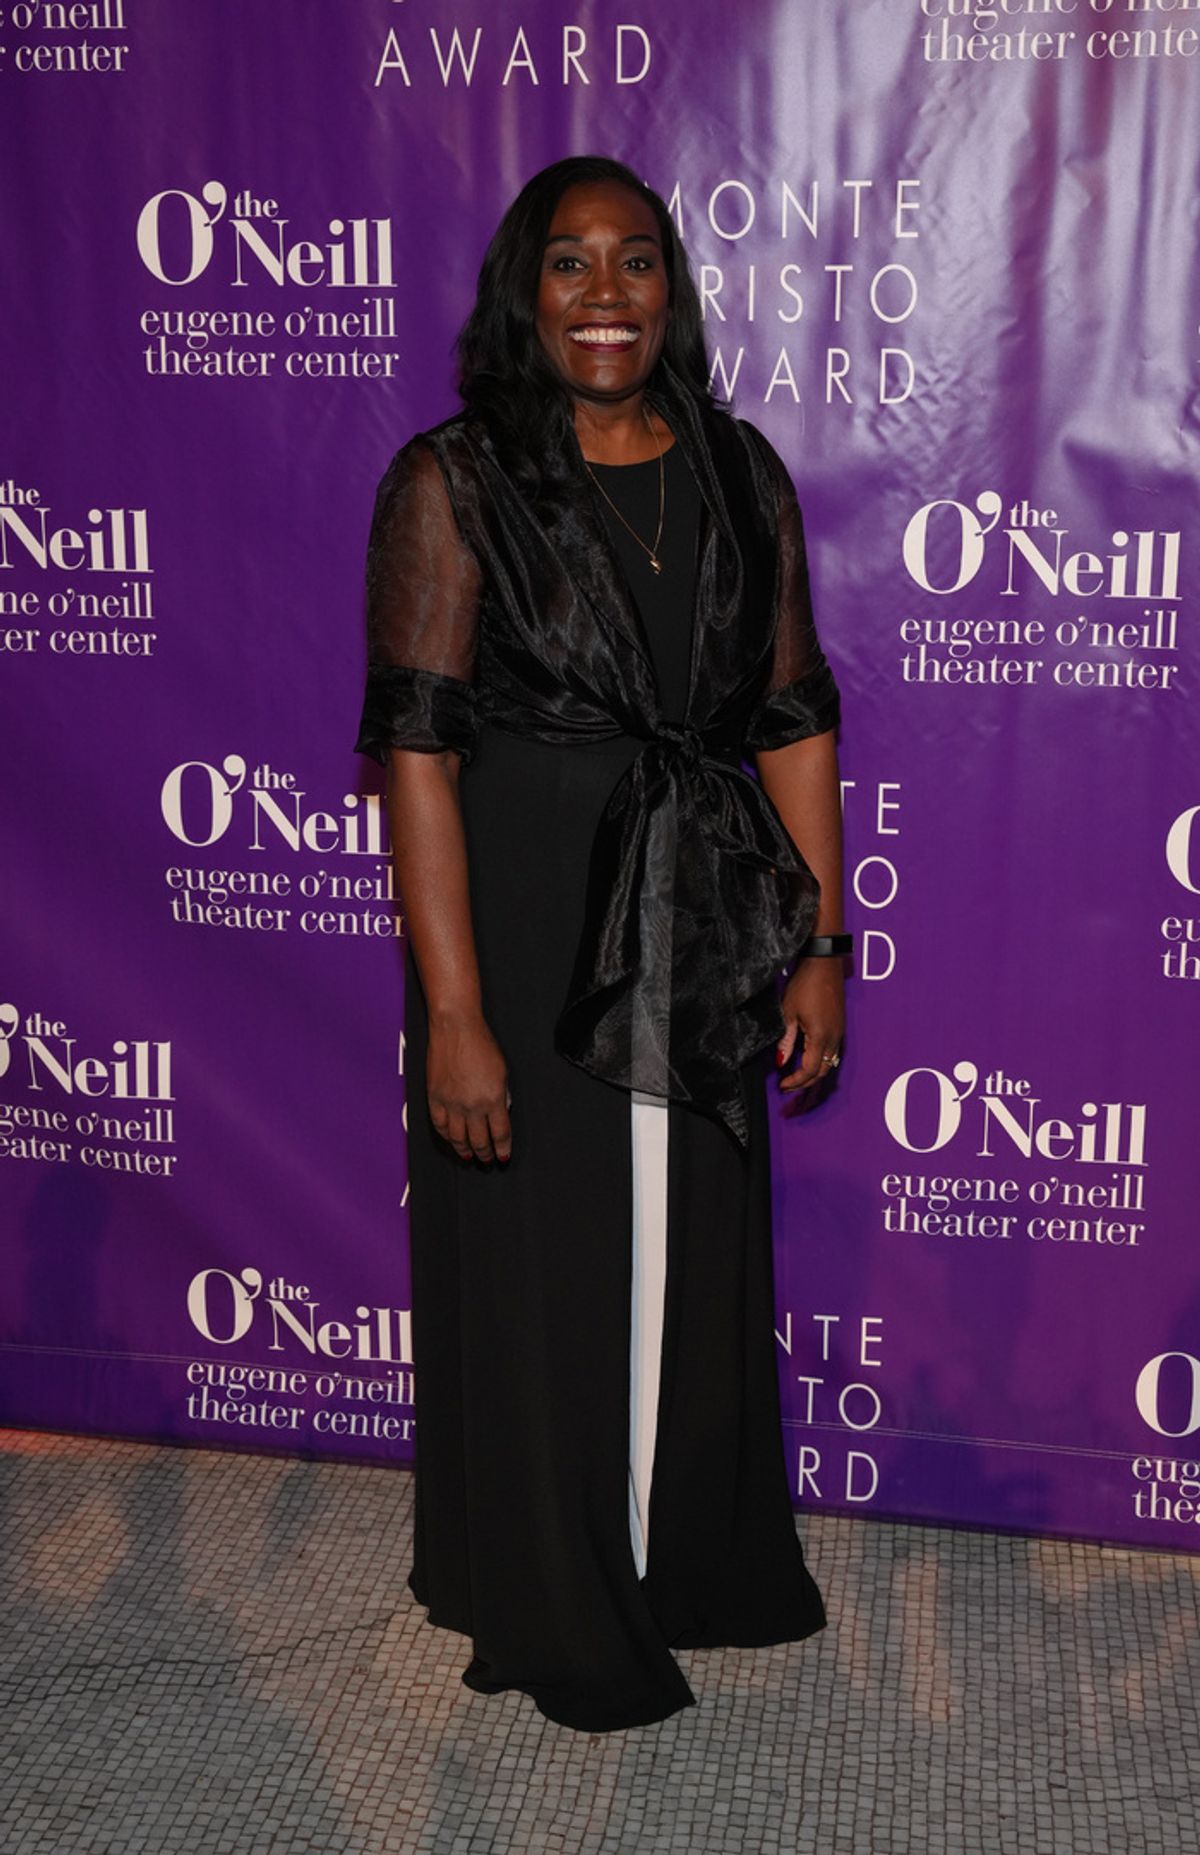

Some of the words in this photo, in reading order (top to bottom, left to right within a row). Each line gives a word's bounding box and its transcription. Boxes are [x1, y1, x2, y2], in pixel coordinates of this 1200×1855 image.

[12, 0, 125, 28] o'neill
[16, 41, 128, 71] center
[375, 25, 650, 86] AWARD
[920, 17, 1076, 62] theater
[235, 191, 278, 217] the
[137, 181, 397, 287] O'Neill
[140, 309, 277, 351] eugene
[285, 298, 396, 337] o'neill
[145, 336, 275, 376] theater
[286, 349, 399, 376] center
[0, 480, 39, 505] the
[1011, 501, 1057, 527] the
[903, 491, 1182, 600] O'Neill
[49, 582, 152, 618] o'neill
[50, 628, 156, 655] center
[899, 618, 1046, 658] eugene
[1056, 610, 1176, 649] o'neill
[899, 645, 1045, 686] theater
[1054, 659, 1178, 688] center
[254, 765, 295, 789] the
[159, 753, 394, 858] O'Neil
[165, 867, 292, 905] eugene
[299, 864, 401, 902] o'neil
[172, 890, 290, 930] theater
[26, 1013, 66, 1036] the
[986, 1071, 1030, 1096] the
[75, 1108, 176, 1144] o'neill
[885, 1061, 1147, 1166] O'Neill
[81, 1148, 177, 1175] center
[880, 1172, 1020, 1213] eugene
[1029, 1174, 1143, 1209] o'neill
[882, 1197, 1018, 1240] theater
[1027, 1218, 1144, 1245] center
[269, 1278, 309, 1300] the
[187, 1267, 415, 1364] O'Neill
[185, 1360, 308, 1402] eugene
[315, 1369, 416, 1406] o'neill
[186, 1386, 306, 1430] theater
[312, 1410, 416, 1442] center
